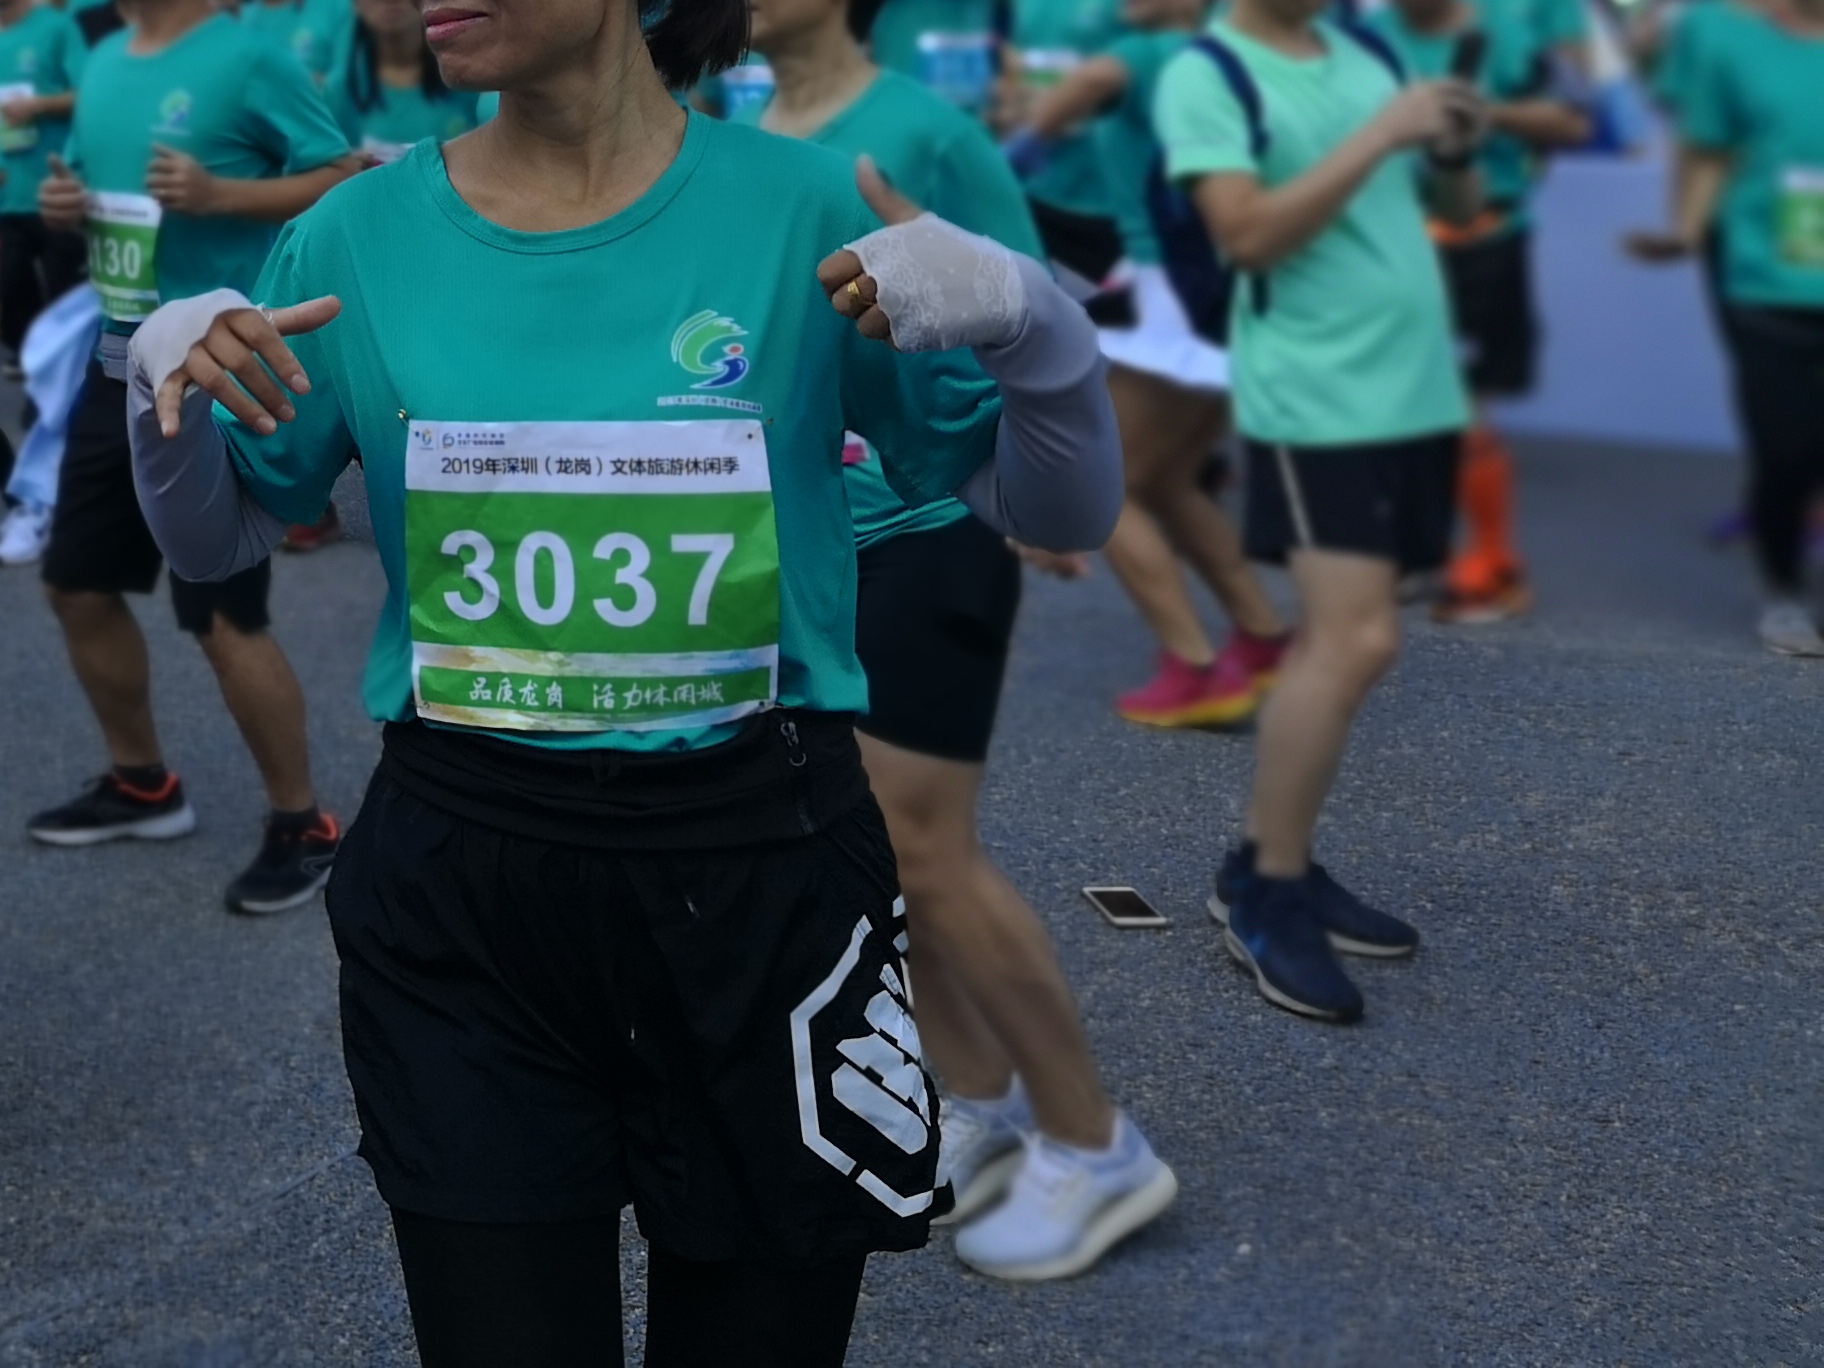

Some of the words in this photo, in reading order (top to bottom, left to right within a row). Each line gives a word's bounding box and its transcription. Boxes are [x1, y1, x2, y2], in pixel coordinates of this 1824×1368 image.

[440, 455, 741, 477] 2019年深圳（龙岗）文体旅游休闲季
[440, 528, 736, 628] 3037
